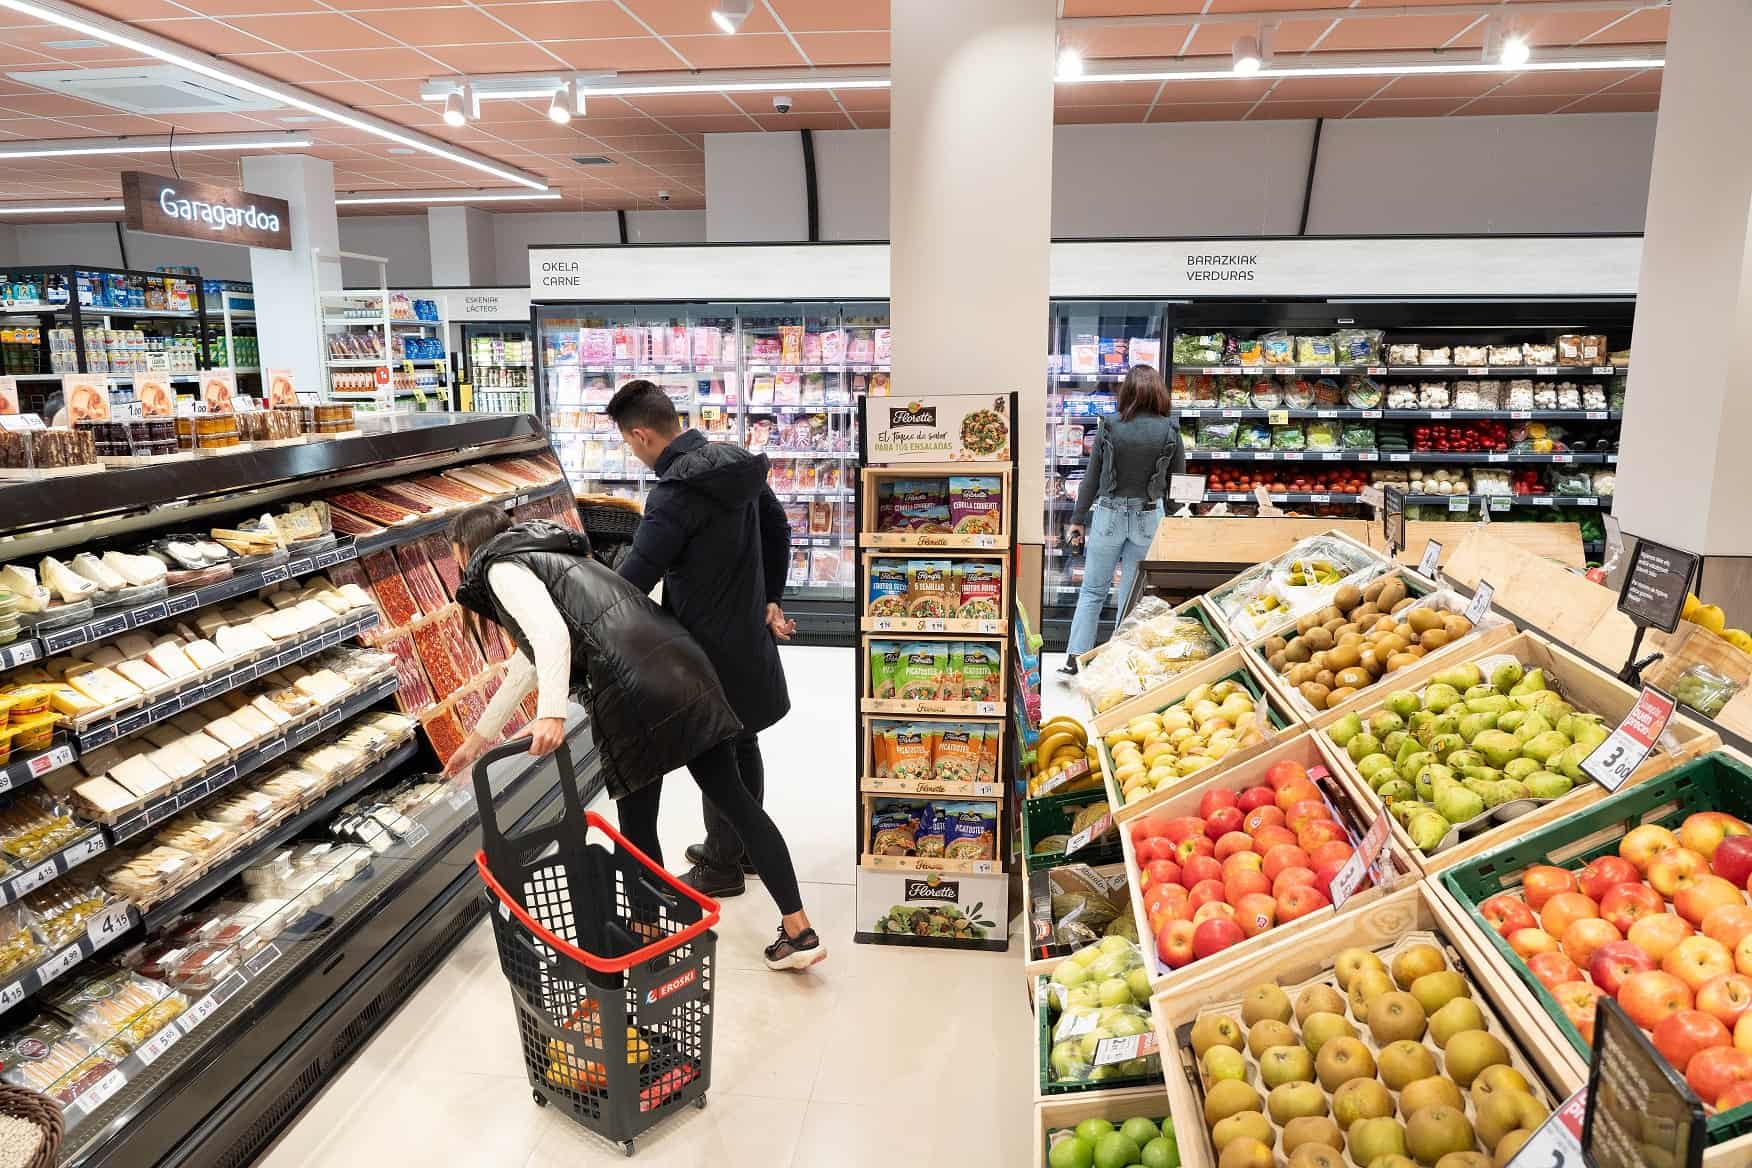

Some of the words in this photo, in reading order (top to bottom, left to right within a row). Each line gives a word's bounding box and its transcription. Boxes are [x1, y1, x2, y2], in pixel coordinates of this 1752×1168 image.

[160, 187, 280, 232] Garagardoa
[1187, 255, 1257, 265] BARAZKIAK
[542, 262, 579, 272] OKELA
[1186, 270, 1255, 280] VERDURAS
[542, 276, 581, 286] CARNE
[892, 410, 935, 424] Florette
[878, 431, 890, 442] El
[916, 430, 926, 440] de
[928, 431, 948, 440] sabor
[910, 442, 952, 450] ENSALADAS
[908, 883, 956, 898] Florette
[661, 970, 694, 995] EROSKI
